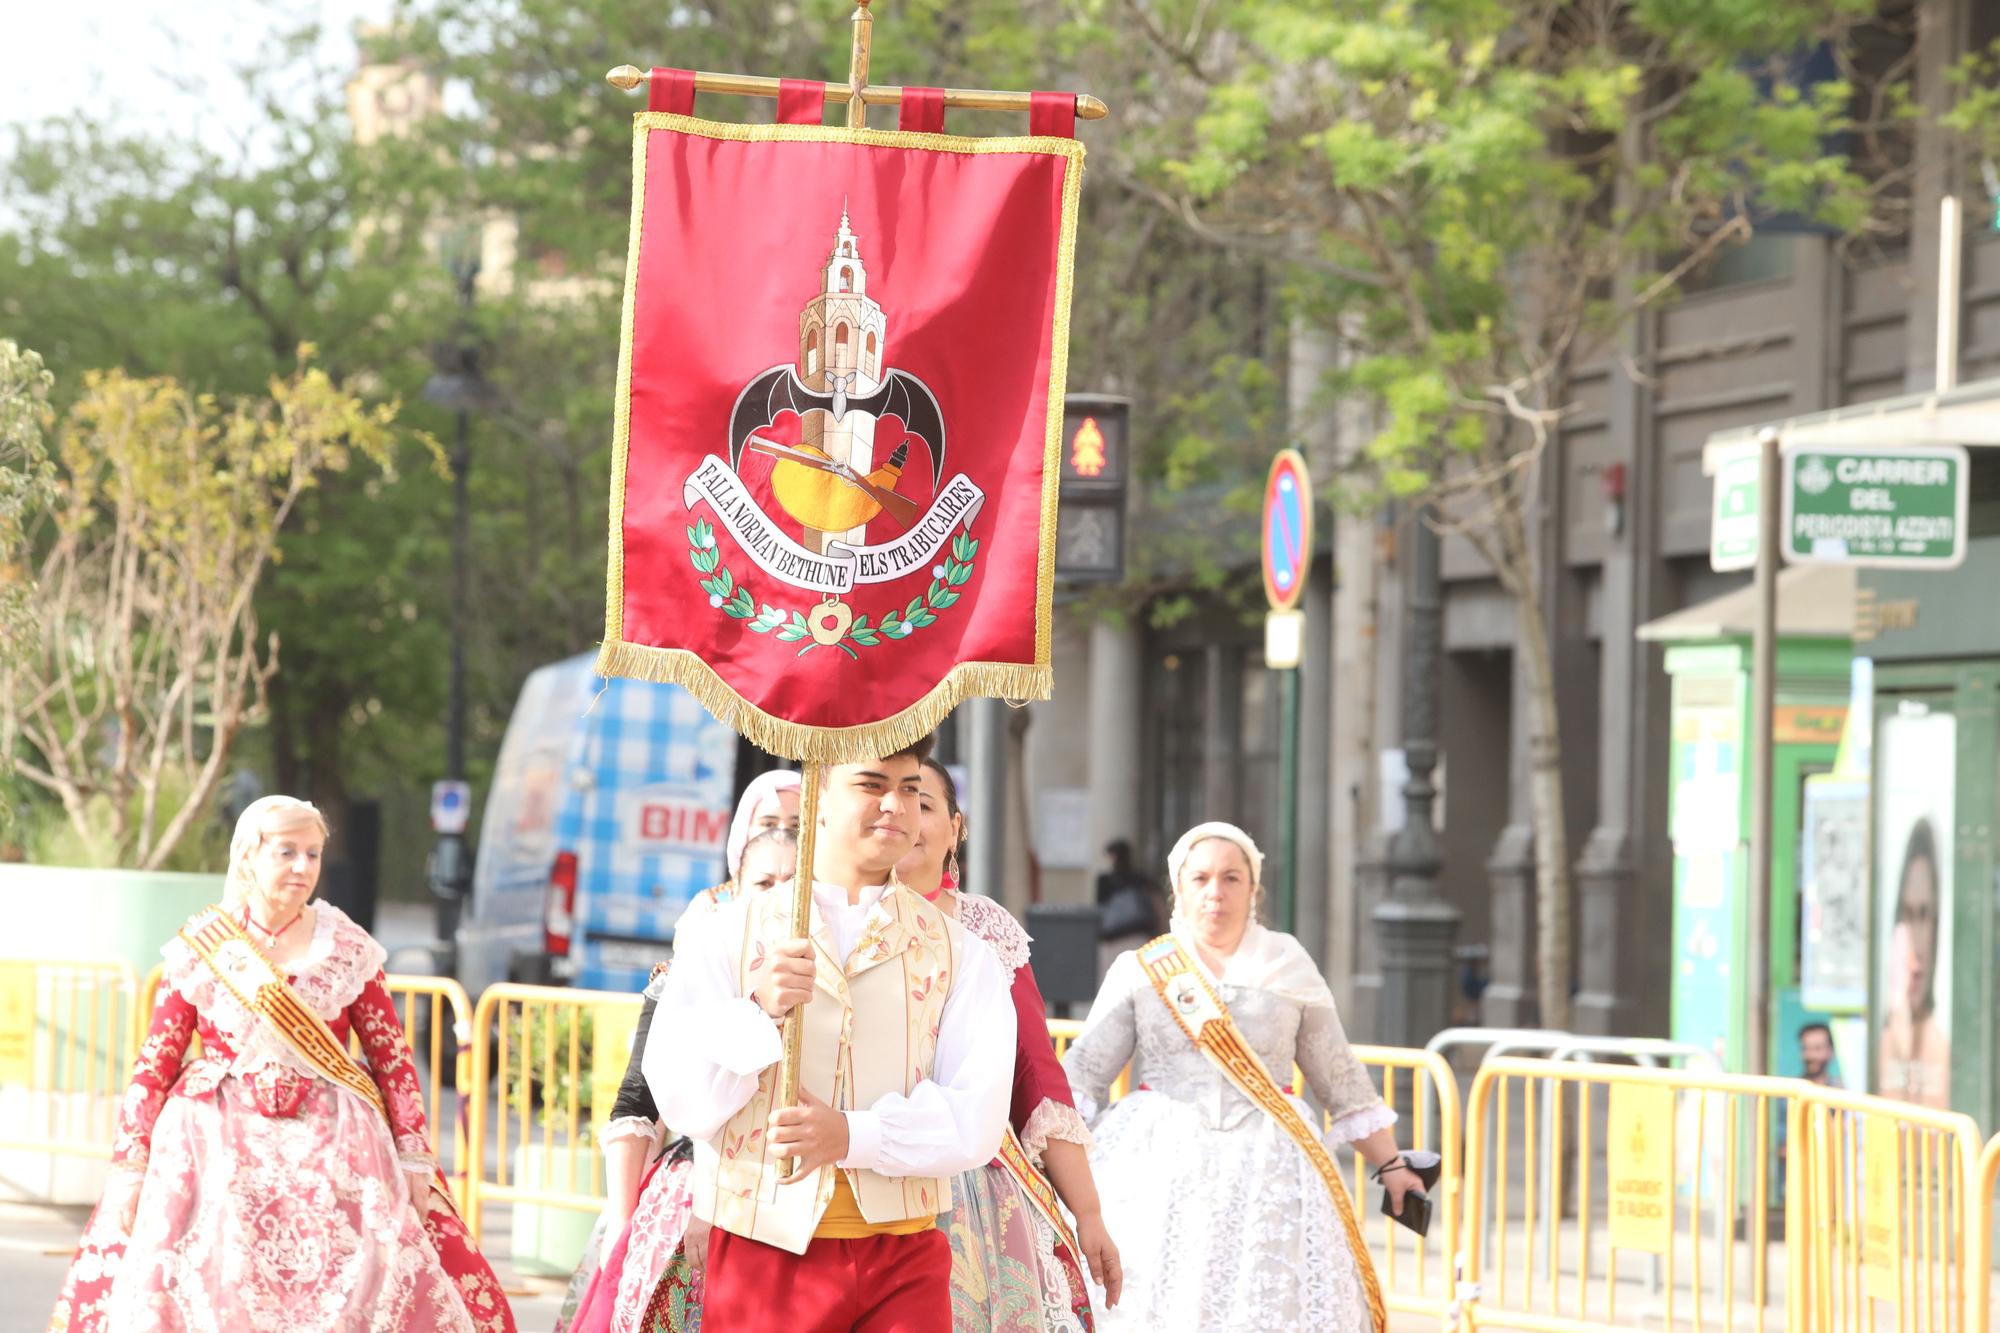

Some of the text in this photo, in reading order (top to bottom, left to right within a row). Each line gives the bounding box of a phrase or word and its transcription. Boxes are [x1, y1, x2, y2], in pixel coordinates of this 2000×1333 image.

[1836, 458, 1949, 486] CARRER
[1849, 487, 1896, 511] DEL
[696, 463, 848, 588] FALLA NORMAN BETHUNE
[859, 481, 975, 577] ELS TRABUCAIRES
